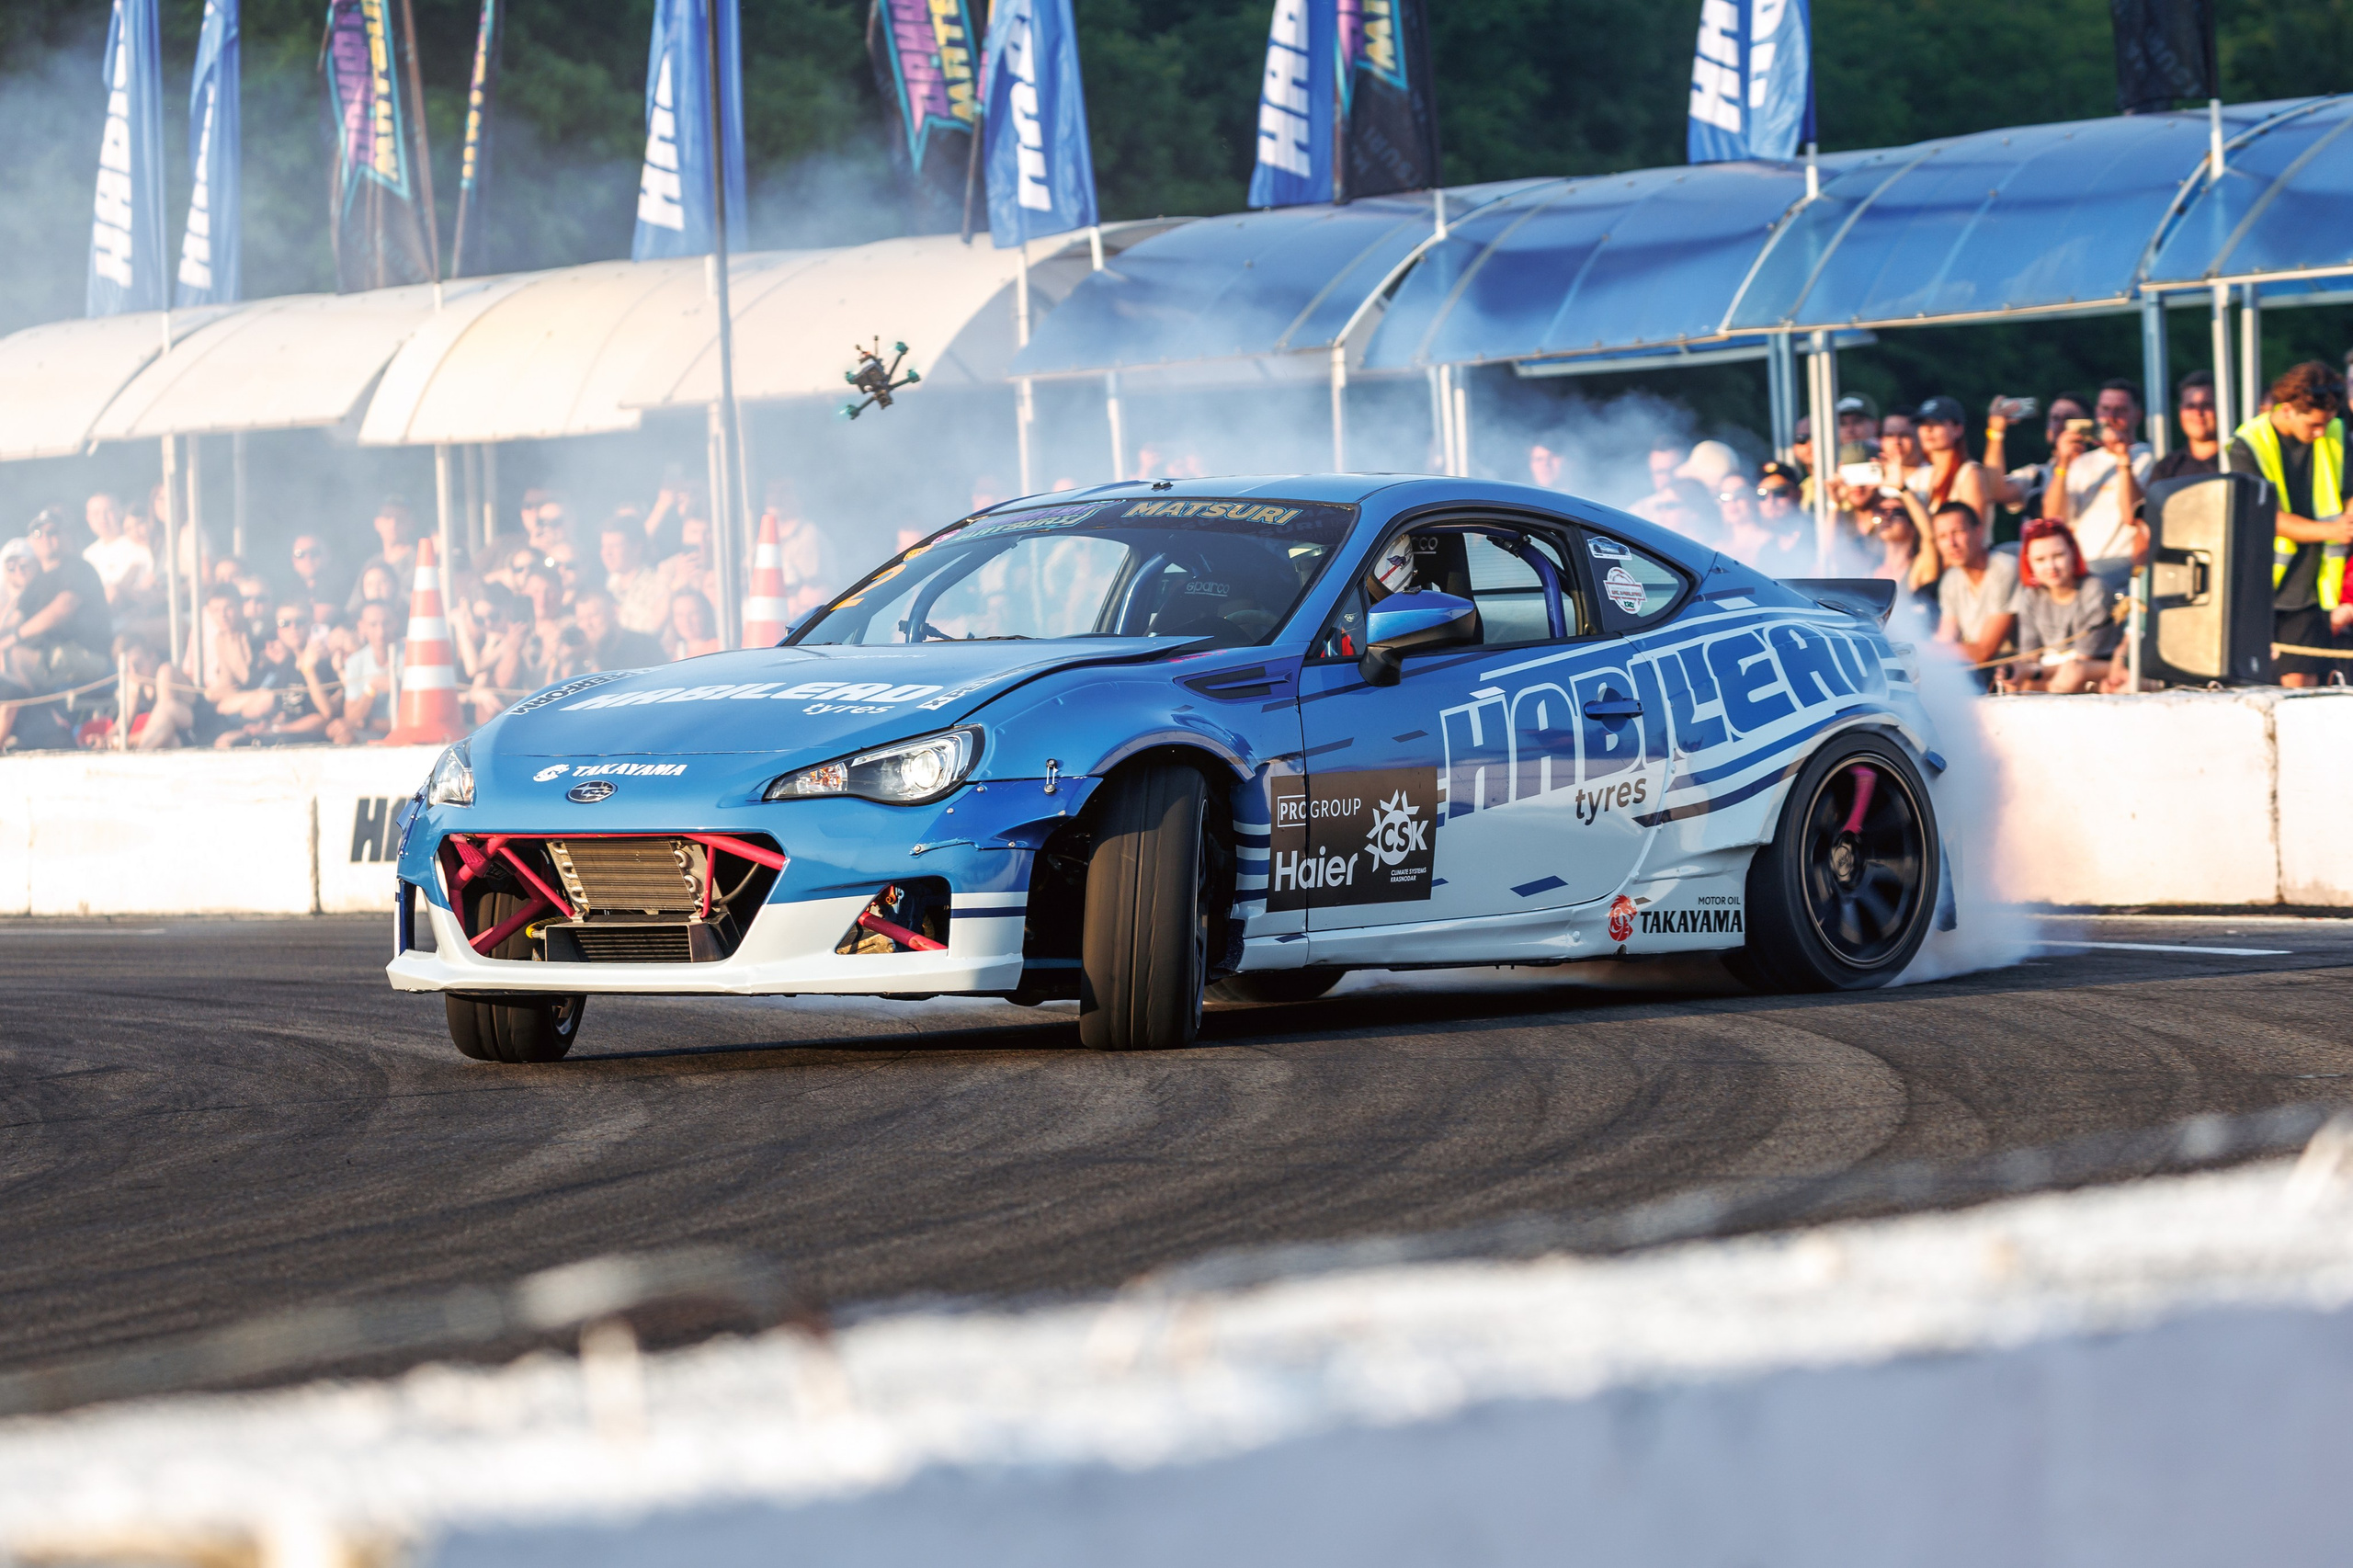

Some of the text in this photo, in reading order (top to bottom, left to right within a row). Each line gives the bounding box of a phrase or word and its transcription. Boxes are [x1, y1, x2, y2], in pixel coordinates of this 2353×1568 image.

[1121, 501, 1302, 526] MATSURI
[1186, 580, 1230, 595] sparco
[558, 681, 944, 711] HABILEAD
[801, 702, 896, 715] tyres
[1440, 621, 1889, 821] HABILEAD
[572, 763, 688, 778] TAKAYAMA
[1574, 778, 1648, 826] tyres
[1381, 820, 1428, 852] CSK
[1275, 845, 1358, 892] Haier
[1698, 896, 1741, 905] MOTOR OIL
[1640, 910, 1744, 934] TAKAYAMA
